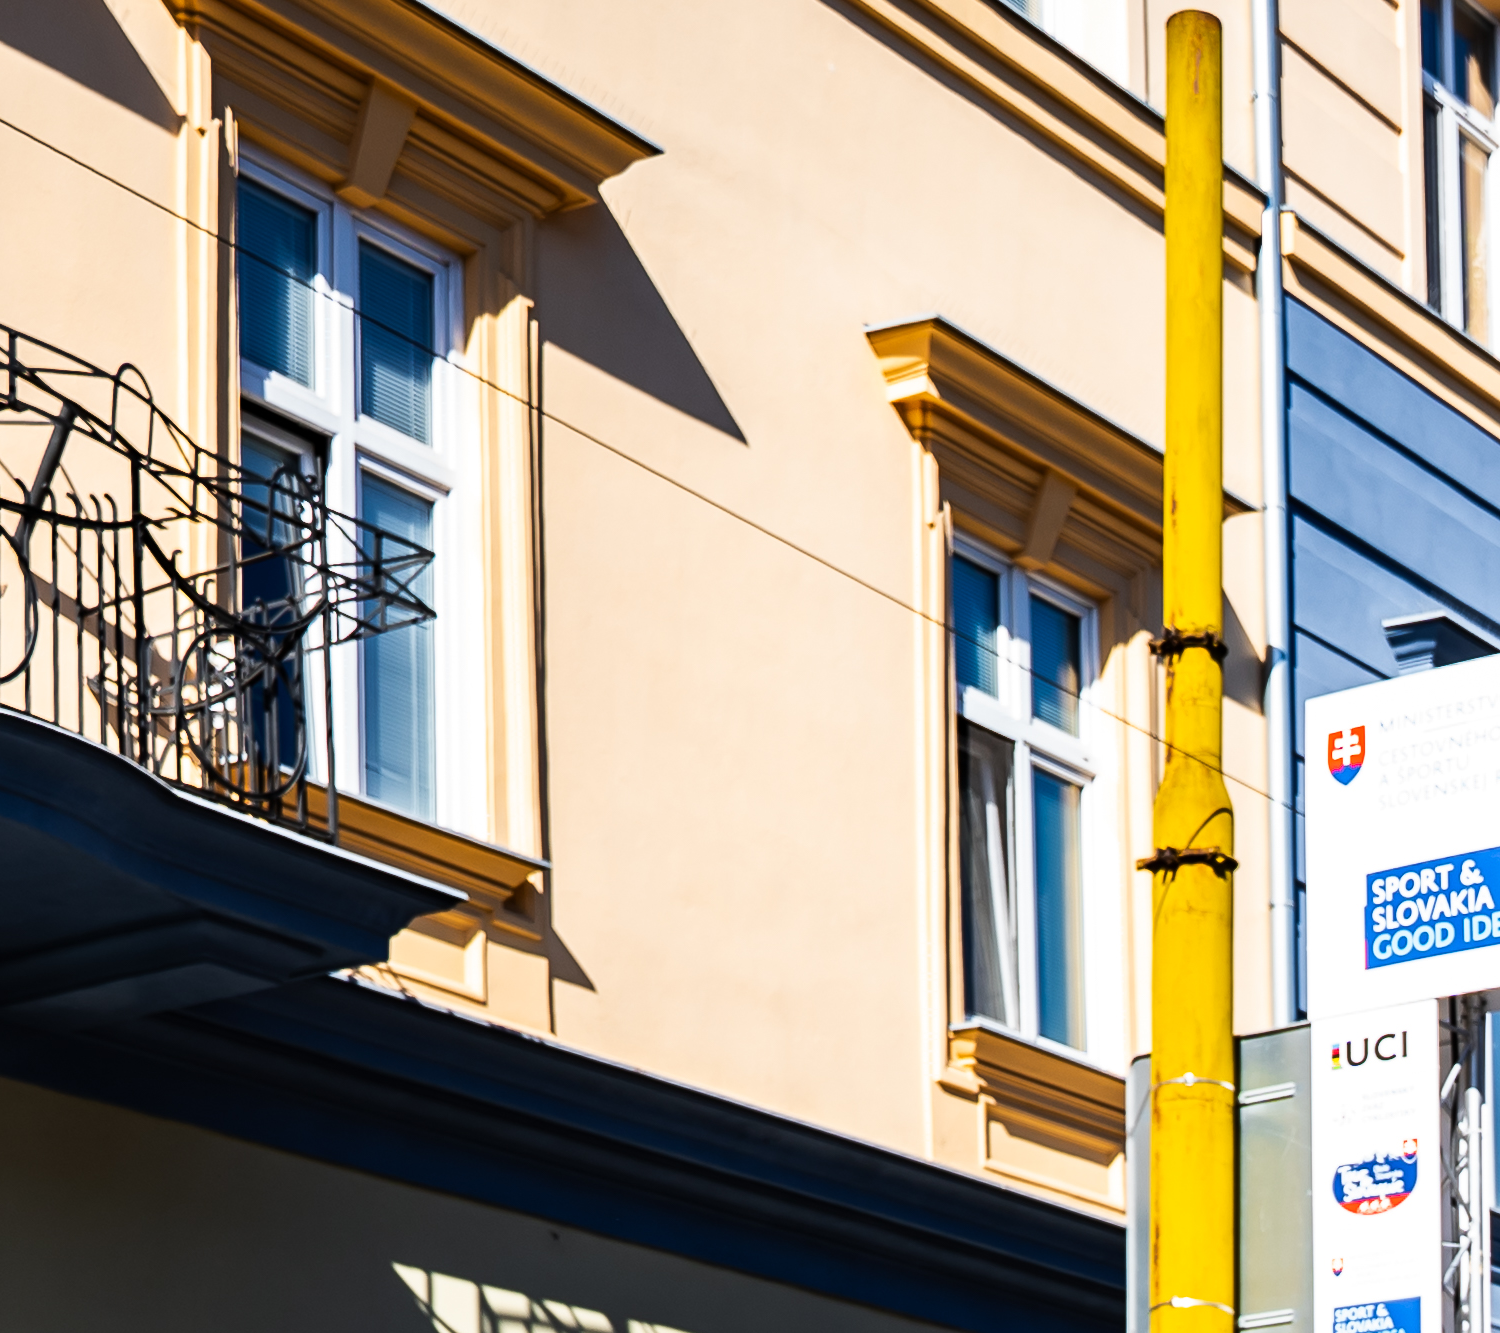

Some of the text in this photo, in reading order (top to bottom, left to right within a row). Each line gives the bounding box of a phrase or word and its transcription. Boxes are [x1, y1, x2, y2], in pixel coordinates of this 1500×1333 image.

[1370, 858, 1485, 905] SPORT &
[1371, 883, 1495, 933] SLOVAKIA
[1372, 920, 1457, 960] GOOD
[1345, 1030, 1409, 1067] UCI
[1334, 1304, 1375, 1323] SPORT
